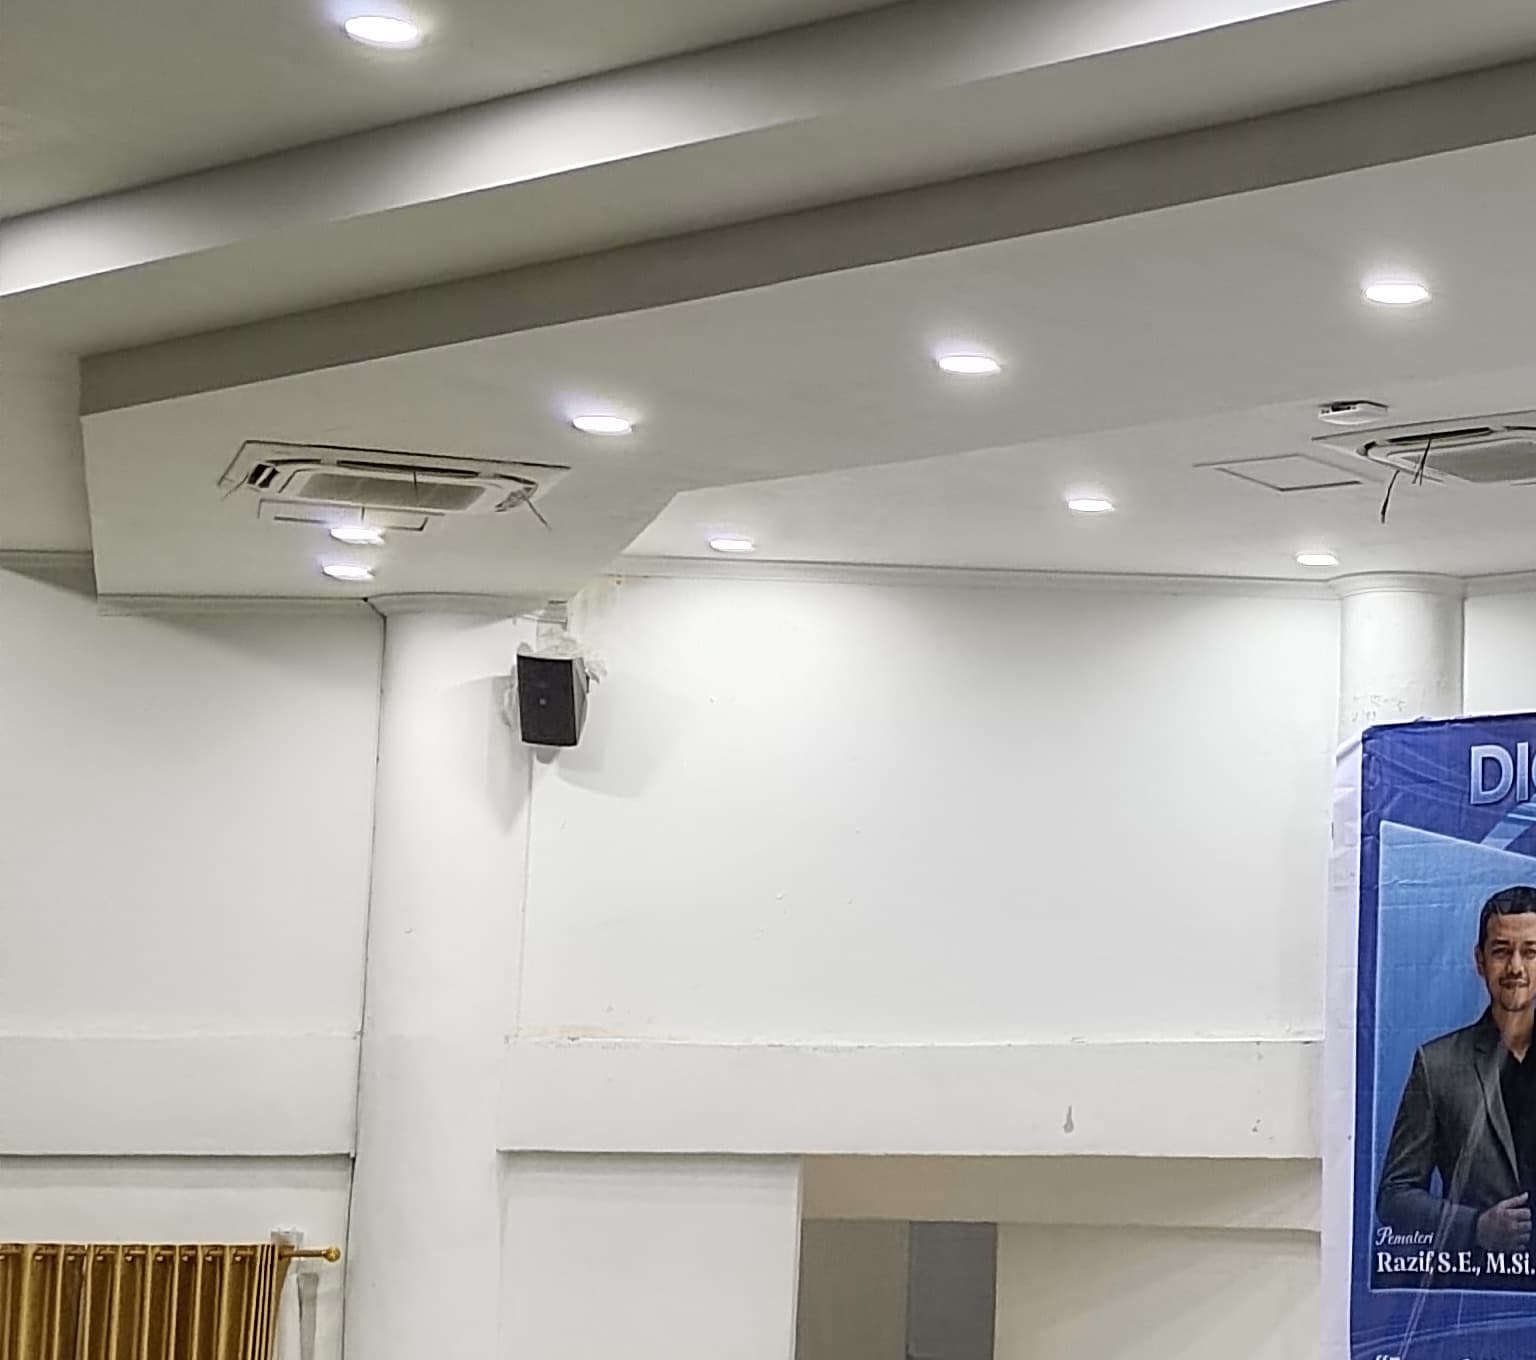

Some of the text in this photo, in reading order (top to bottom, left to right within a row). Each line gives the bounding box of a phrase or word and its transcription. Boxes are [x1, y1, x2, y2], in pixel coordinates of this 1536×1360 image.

[1376, 1226, 1433, 1246] Pemateri
[1377, 1250, 1434, 1275] Razif,
[1438, 1251, 1481, 1276] S.E.,
